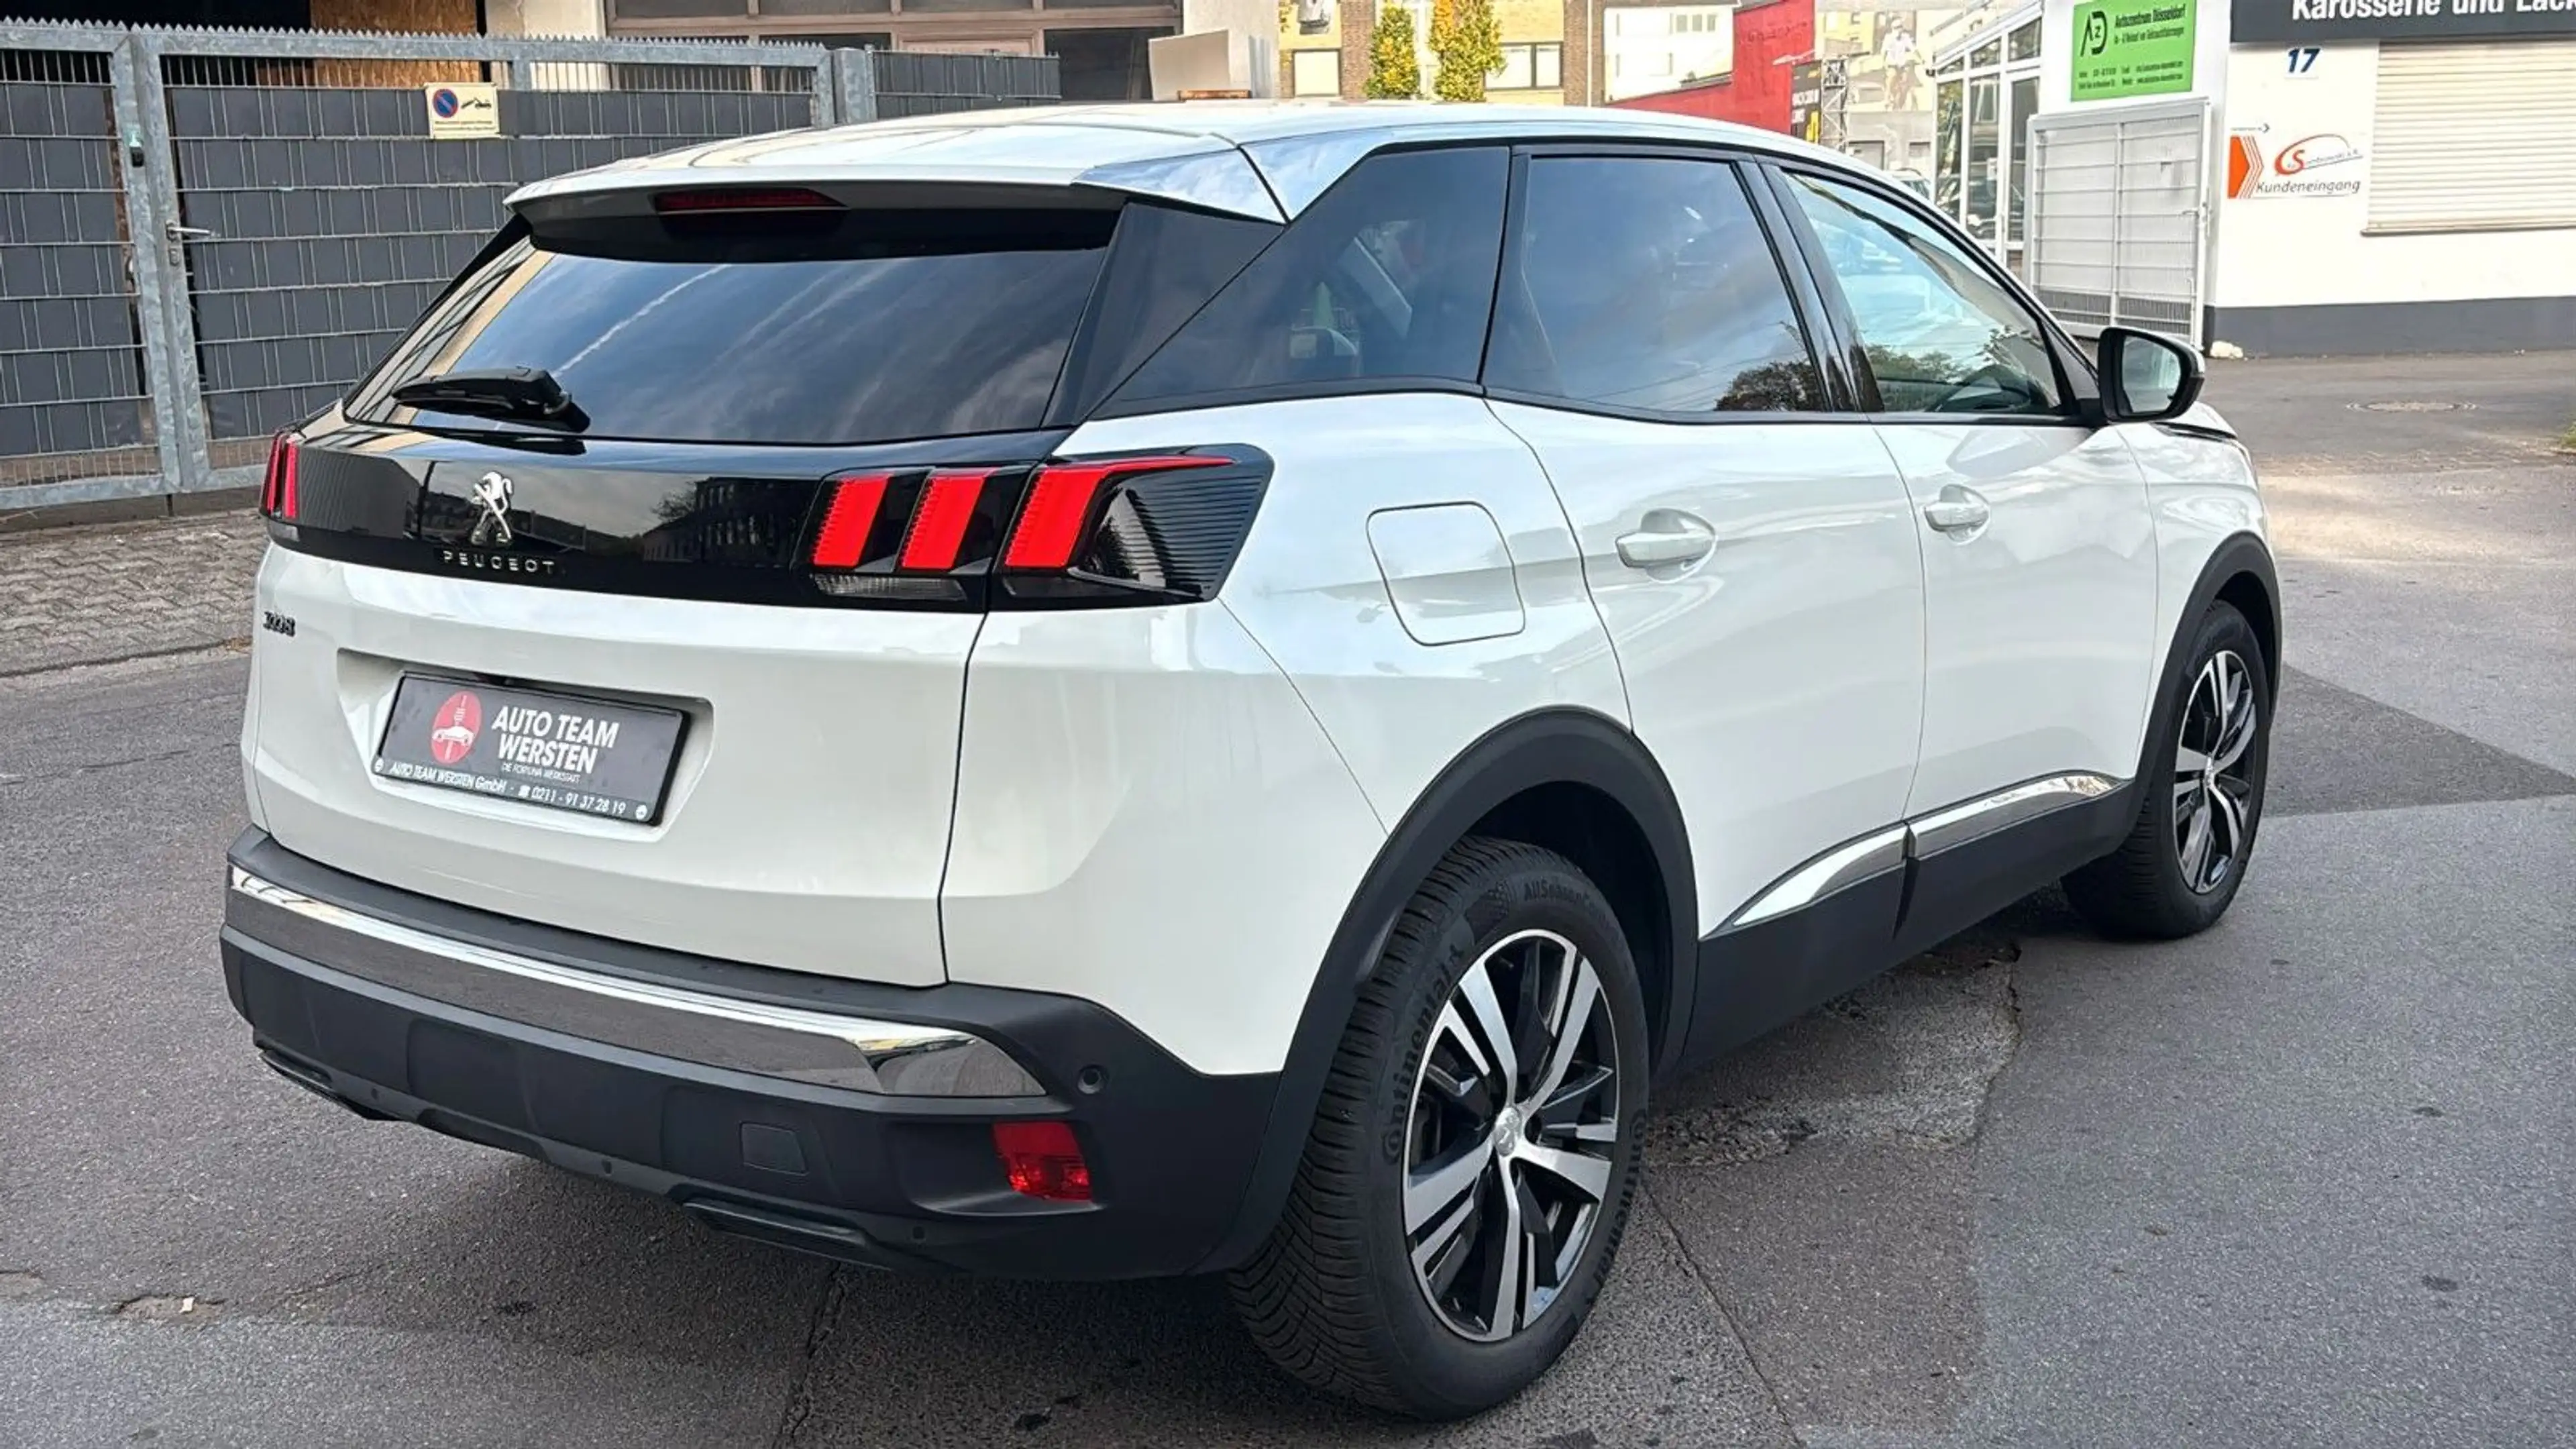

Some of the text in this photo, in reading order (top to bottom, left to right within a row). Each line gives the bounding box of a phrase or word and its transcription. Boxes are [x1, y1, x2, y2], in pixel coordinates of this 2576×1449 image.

[2292, 0, 2440, 20] Karosserie
[2288, 48, 2320, 73] 17
[2255, 179, 2361, 194] Kundeneingang
[443, 550, 555, 574] PEUGEOT
[492, 706, 619, 748] AUTO TEAM
[498, 733, 598, 773] WERSTEN
[389, 762, 413, 777] AUTO
[413, 765, 437, 781] TEAM
[437, 769, 475, 788] WERSTEN
[475, 775, 508, 793] GmbH
[531, 786, 557, 802] 0211
[566, 792, 579, 806] 91
[580, 795, 595, 810] 37
[595, 798, 610, 812] 28
[612, 800, 627, 814] 19
